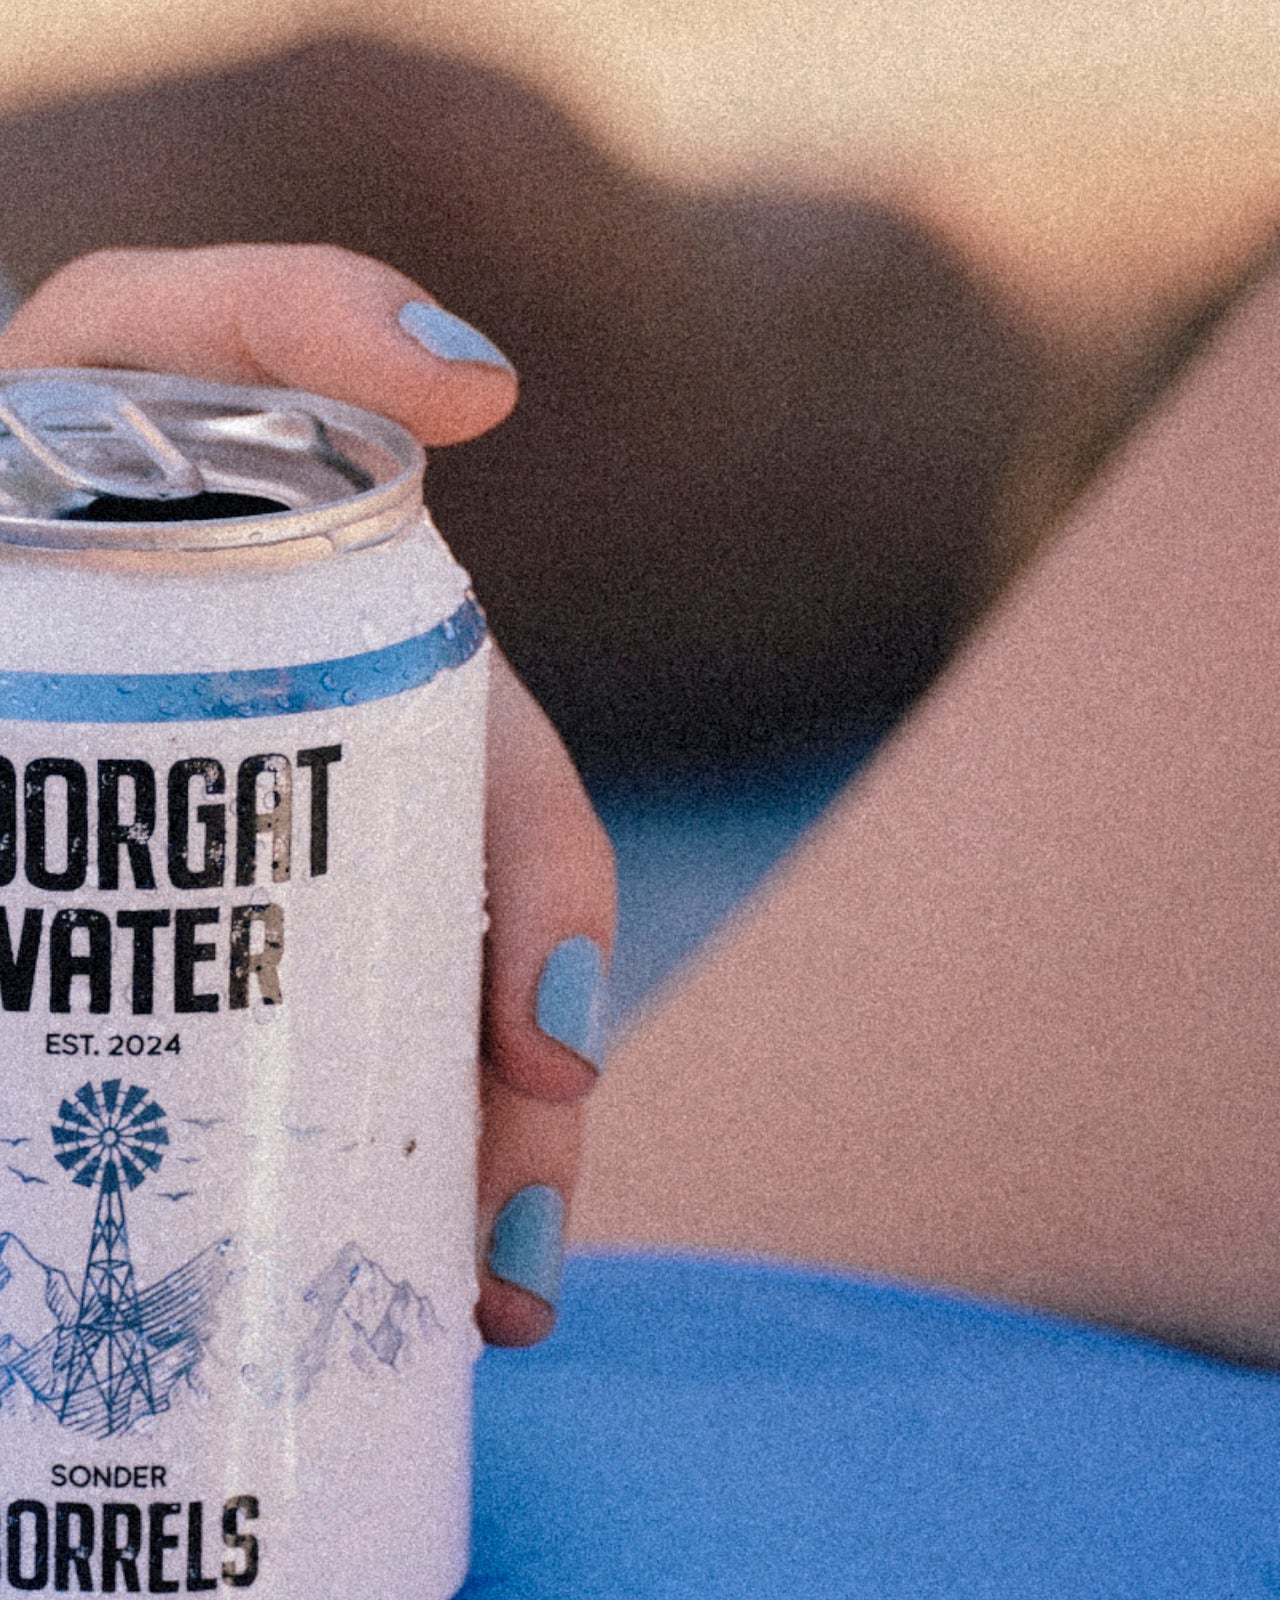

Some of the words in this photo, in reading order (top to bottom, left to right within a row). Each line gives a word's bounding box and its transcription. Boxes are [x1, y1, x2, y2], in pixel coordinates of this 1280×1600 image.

[45, 1032, 100, 1056] EST.
[108, 1032, 182, 1056] 2024
[50, 1463, 168, 1489] SONDER
